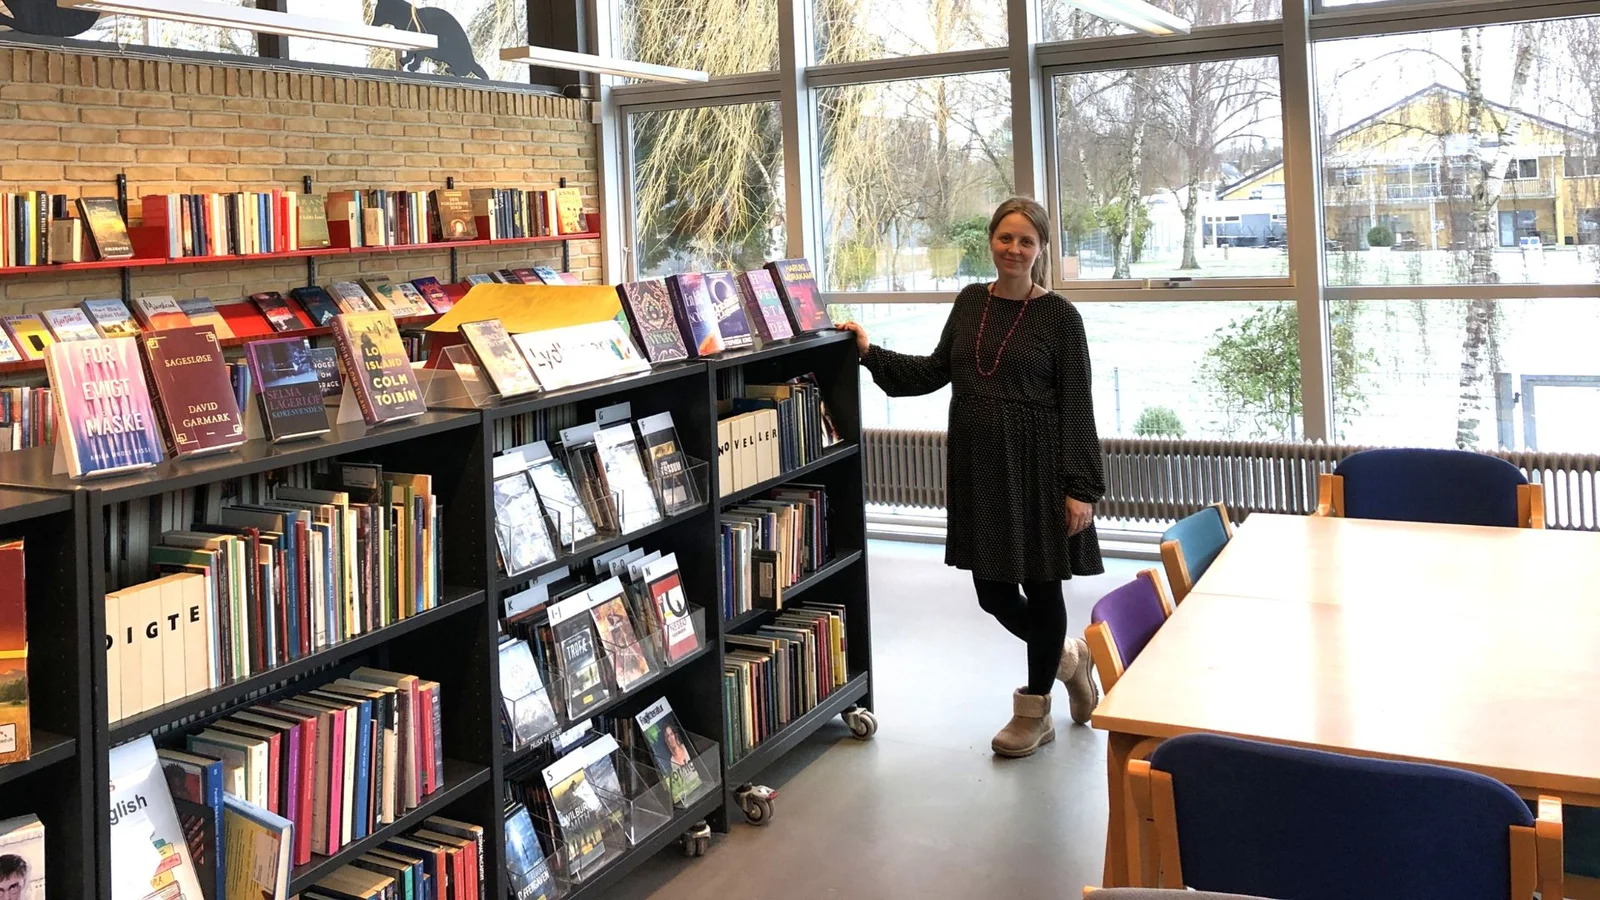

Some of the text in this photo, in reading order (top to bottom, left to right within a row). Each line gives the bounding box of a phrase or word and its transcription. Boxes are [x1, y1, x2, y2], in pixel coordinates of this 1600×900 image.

[785, 263, 806, 272] HARUKI
[783, 272, 814, 282] MURAKAMI
[332, 321, 342, 342] COLM
[82, 345, 116, 363] FOR
[164, 354, 213, 367] SAGESLØSE
[365, 358, 403, 370] ISLAND
[373, 373, 409, 389] COLM
[82, 378, 131, 401] EVIGT
[267, 386, 302, 400] SELMA
[375, 387, 418, 406] TÓIBÍN
[188, 402, 218, 414] DAVID
[85, 410, 145, 437] MÅSKE
[183, 412, 231, 428] GARMARK
[718, 428, 778, 458] NOVELLER
[645, 566, 651, 577] N
[587, 592, 594, 602] L
[508, 600, 514, 611] K
[105, 605, 200, 650] DIGTE
[547, 772, 554, 781] S
[109, 793, 148, 827] glish
[565, 802, 589, 822] WILBUR
